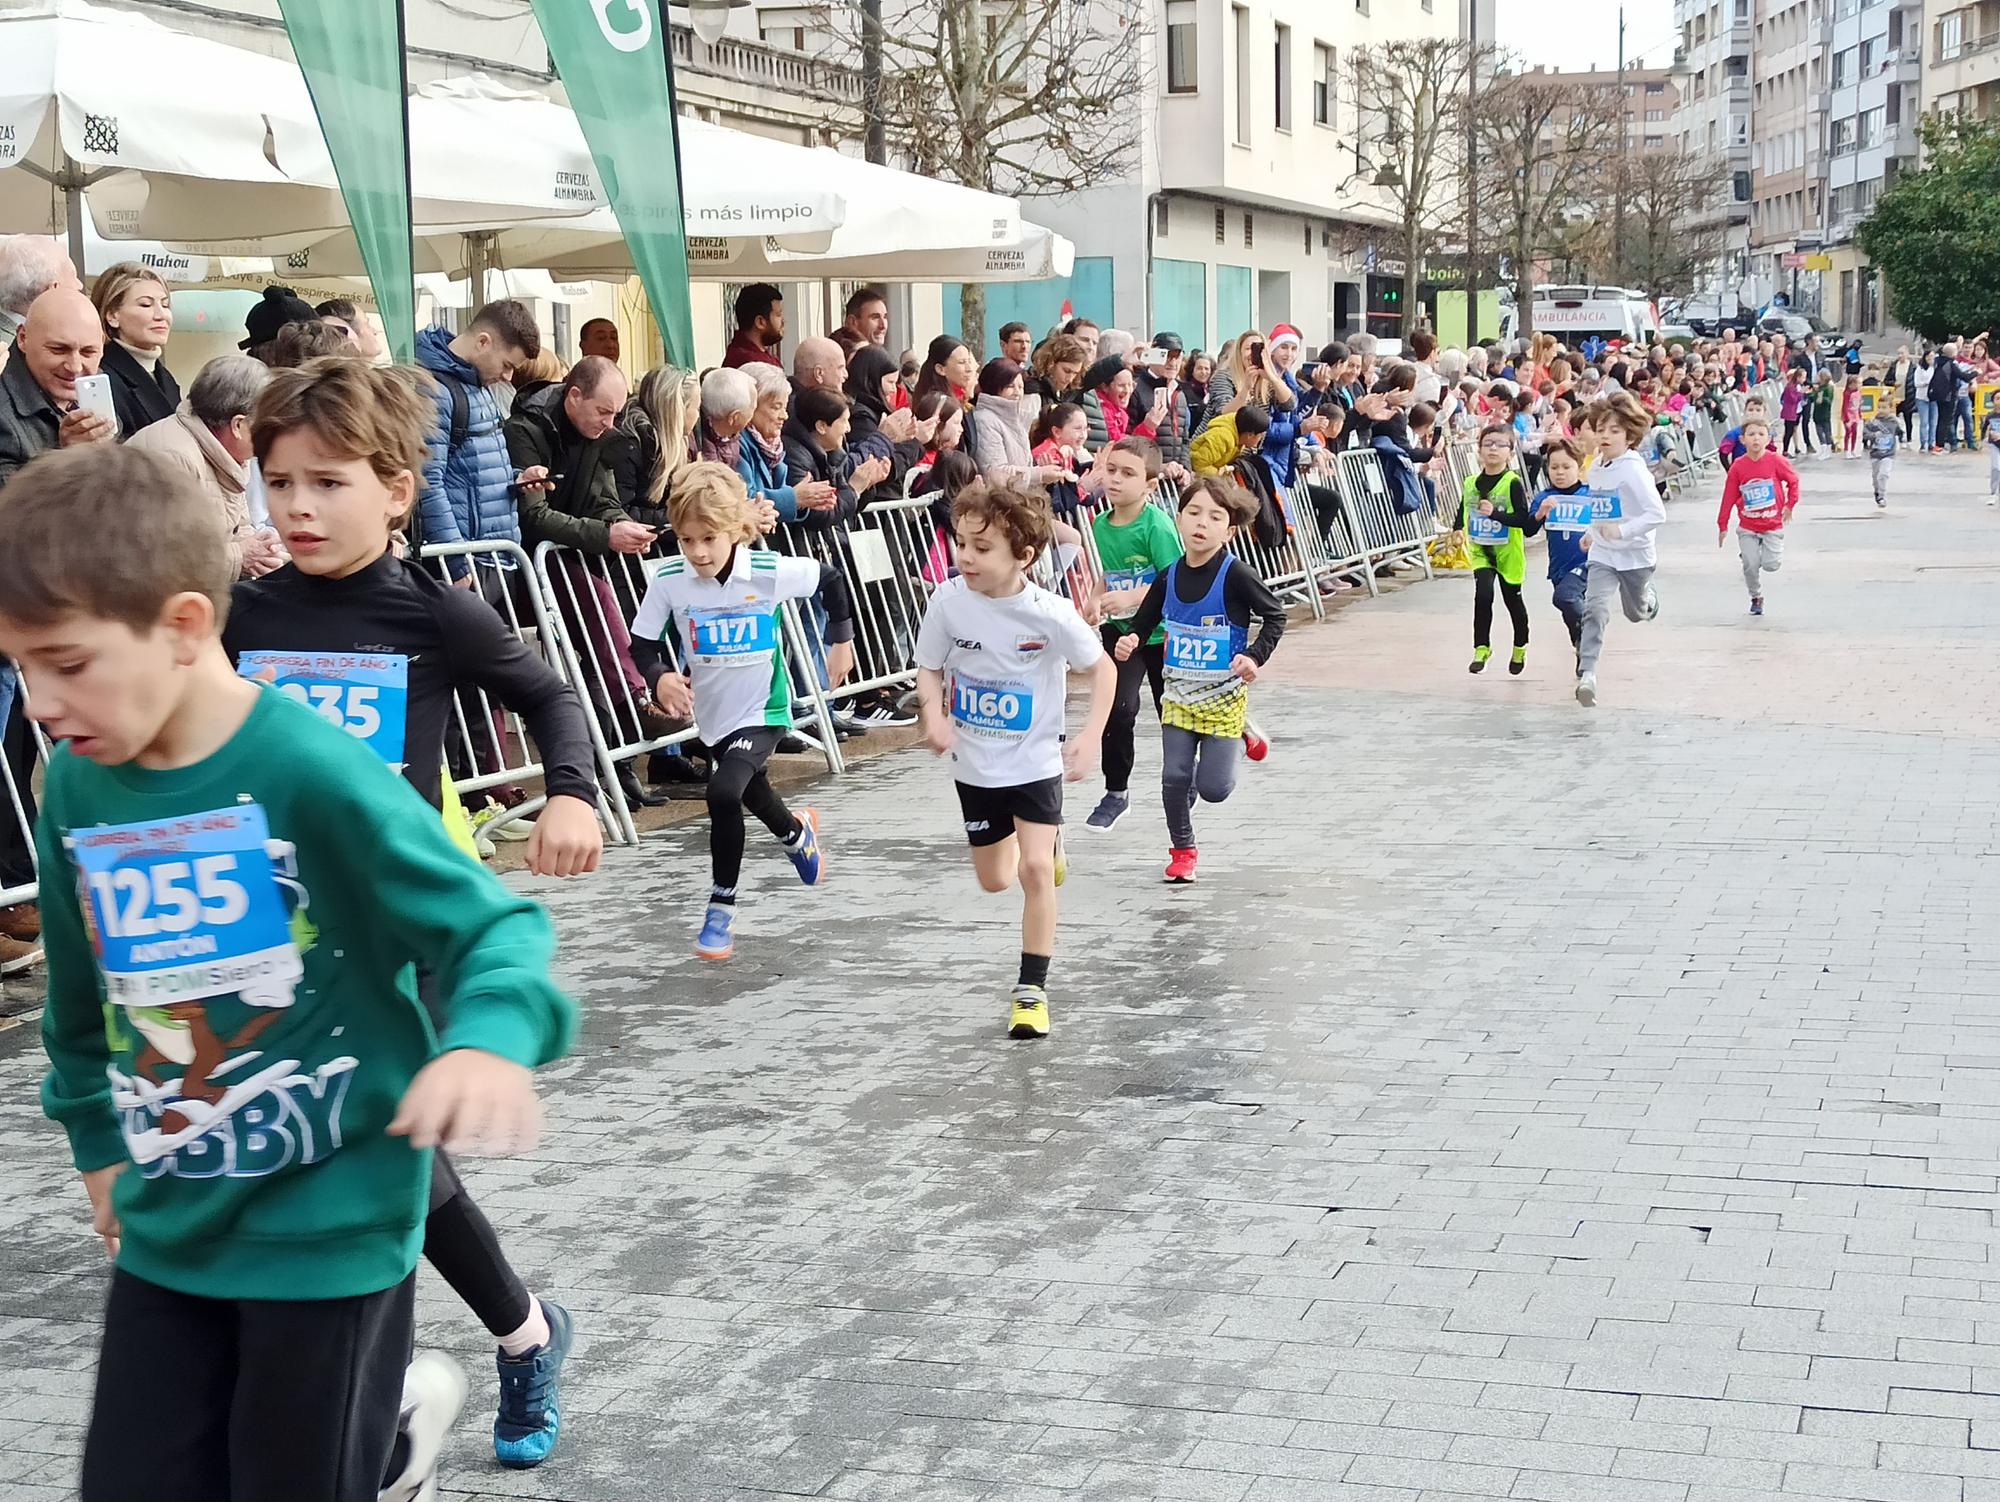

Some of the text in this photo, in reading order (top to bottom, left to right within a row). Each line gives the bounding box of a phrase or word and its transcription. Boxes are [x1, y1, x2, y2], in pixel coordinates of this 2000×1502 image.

[556, 172, 590, 187] CERVEZAS
[554, 187, 596, 201] ALHAMBRA
[700, 204, 743, 221] más
[750, 203, 813, 222] limpio
[689, 236, 728, 248] CERVEZAS
[141, 254, 189, 269] Mahou
[687, 249, 729, 260] ALHAMBRA
[988, 251, 1024, 260] CERVEZAS
[985, 262, 1025, 271] ALHAMBRA
[256, 275, 262, 284] a
[292, 285, 336, 301] respires
[1744, 486, 1770, 502] 1158
[1556, 503, 1583, 518] 1117
[1472, 518, 1502, 533] 1199
[704, 616, 758, 644] 1171
[1173, 635, 1217, 660] 1212
[253, 656, 388, 670] CARRERA FIN DE AÑO
[1179, 660, 1206, 669] GUILLE
[958, 684, 1019, 719] 1160
[966, 714, 1007, 728] SAMUEL
[91, 854, 250, 938] 1255
[130, 934, 218, 963] ANTÓN
[147, 960, 273, 994] PDMSiero
